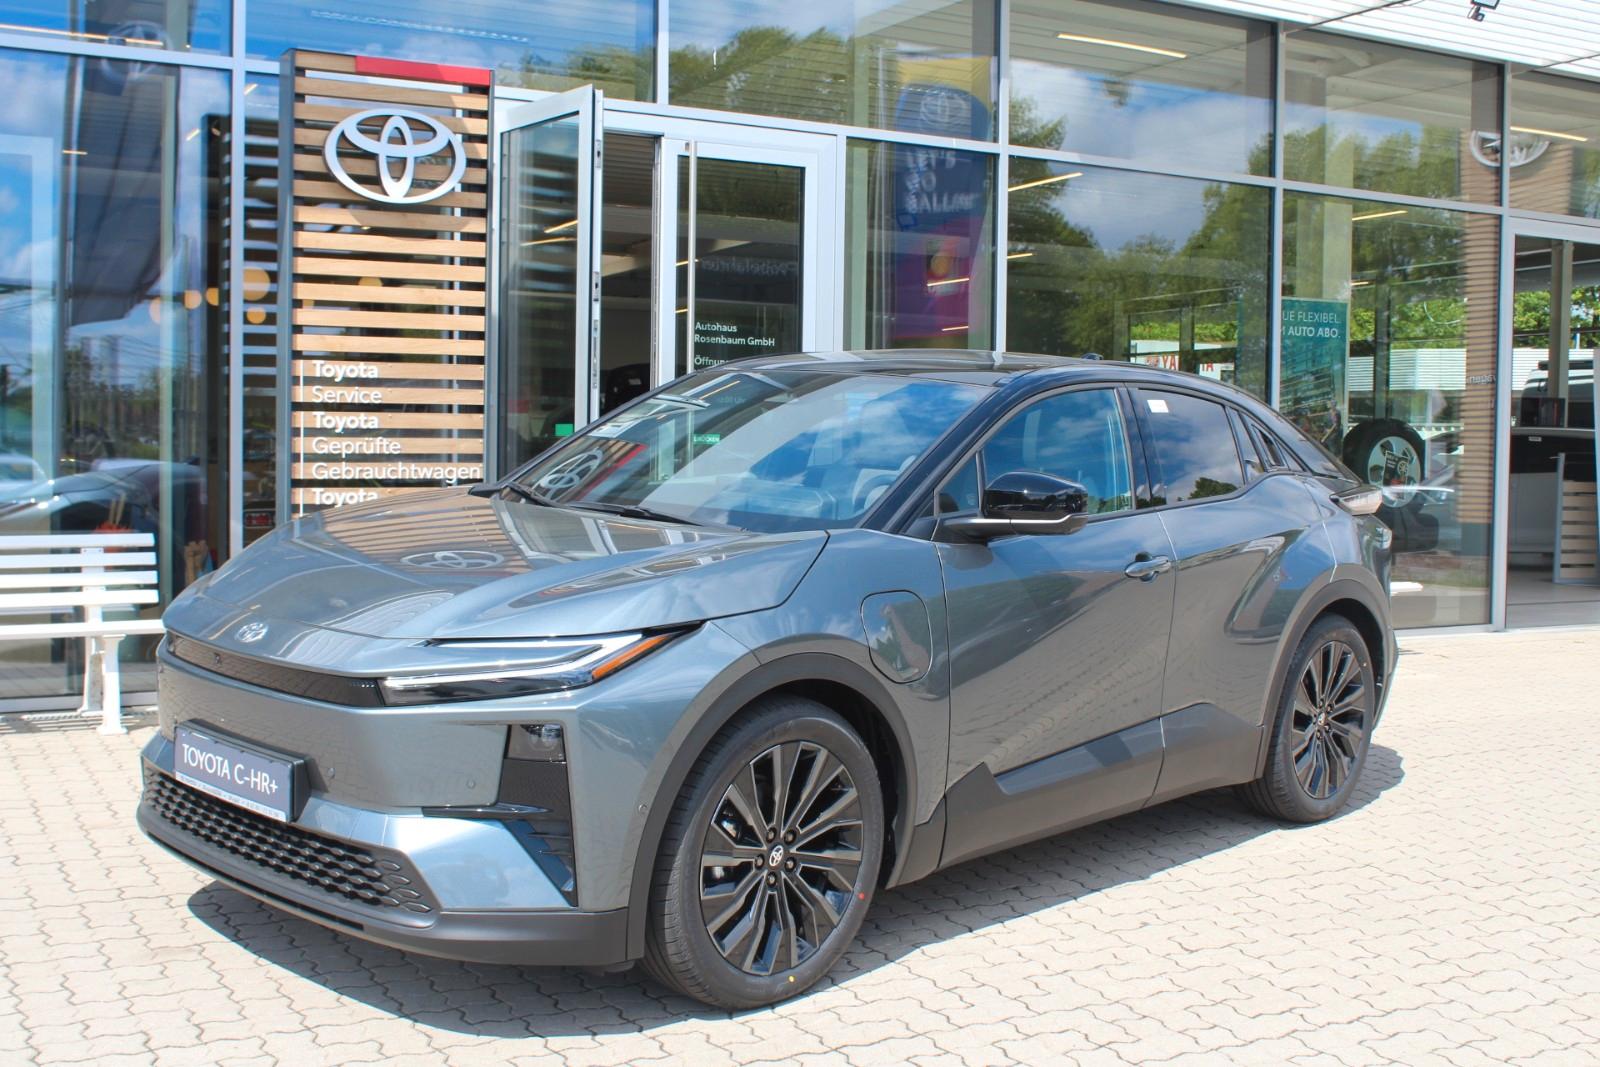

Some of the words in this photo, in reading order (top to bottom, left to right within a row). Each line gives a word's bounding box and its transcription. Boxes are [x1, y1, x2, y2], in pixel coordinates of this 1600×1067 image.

[695, 321, 738, 332] Autohaus
[1287, 326, 1315, 337] AUTO
[1316, 327, 1341, 338] ABO.
[694, 334, 746, 345] Rosenbaum
[747, 336, 775, 347] GmbH
[312, 360, 379, 382] Toyota
[311, 385, 383, 404] Service
[312, 411, 379, 433] Toyota
[312, 437, 402, 458] Geprüfte
[312, 461, 481, 484] Gebrauchtwagen
[182, 743, 231, 780] TOYOTA
[234, 763, 279, 796] C-HR+
